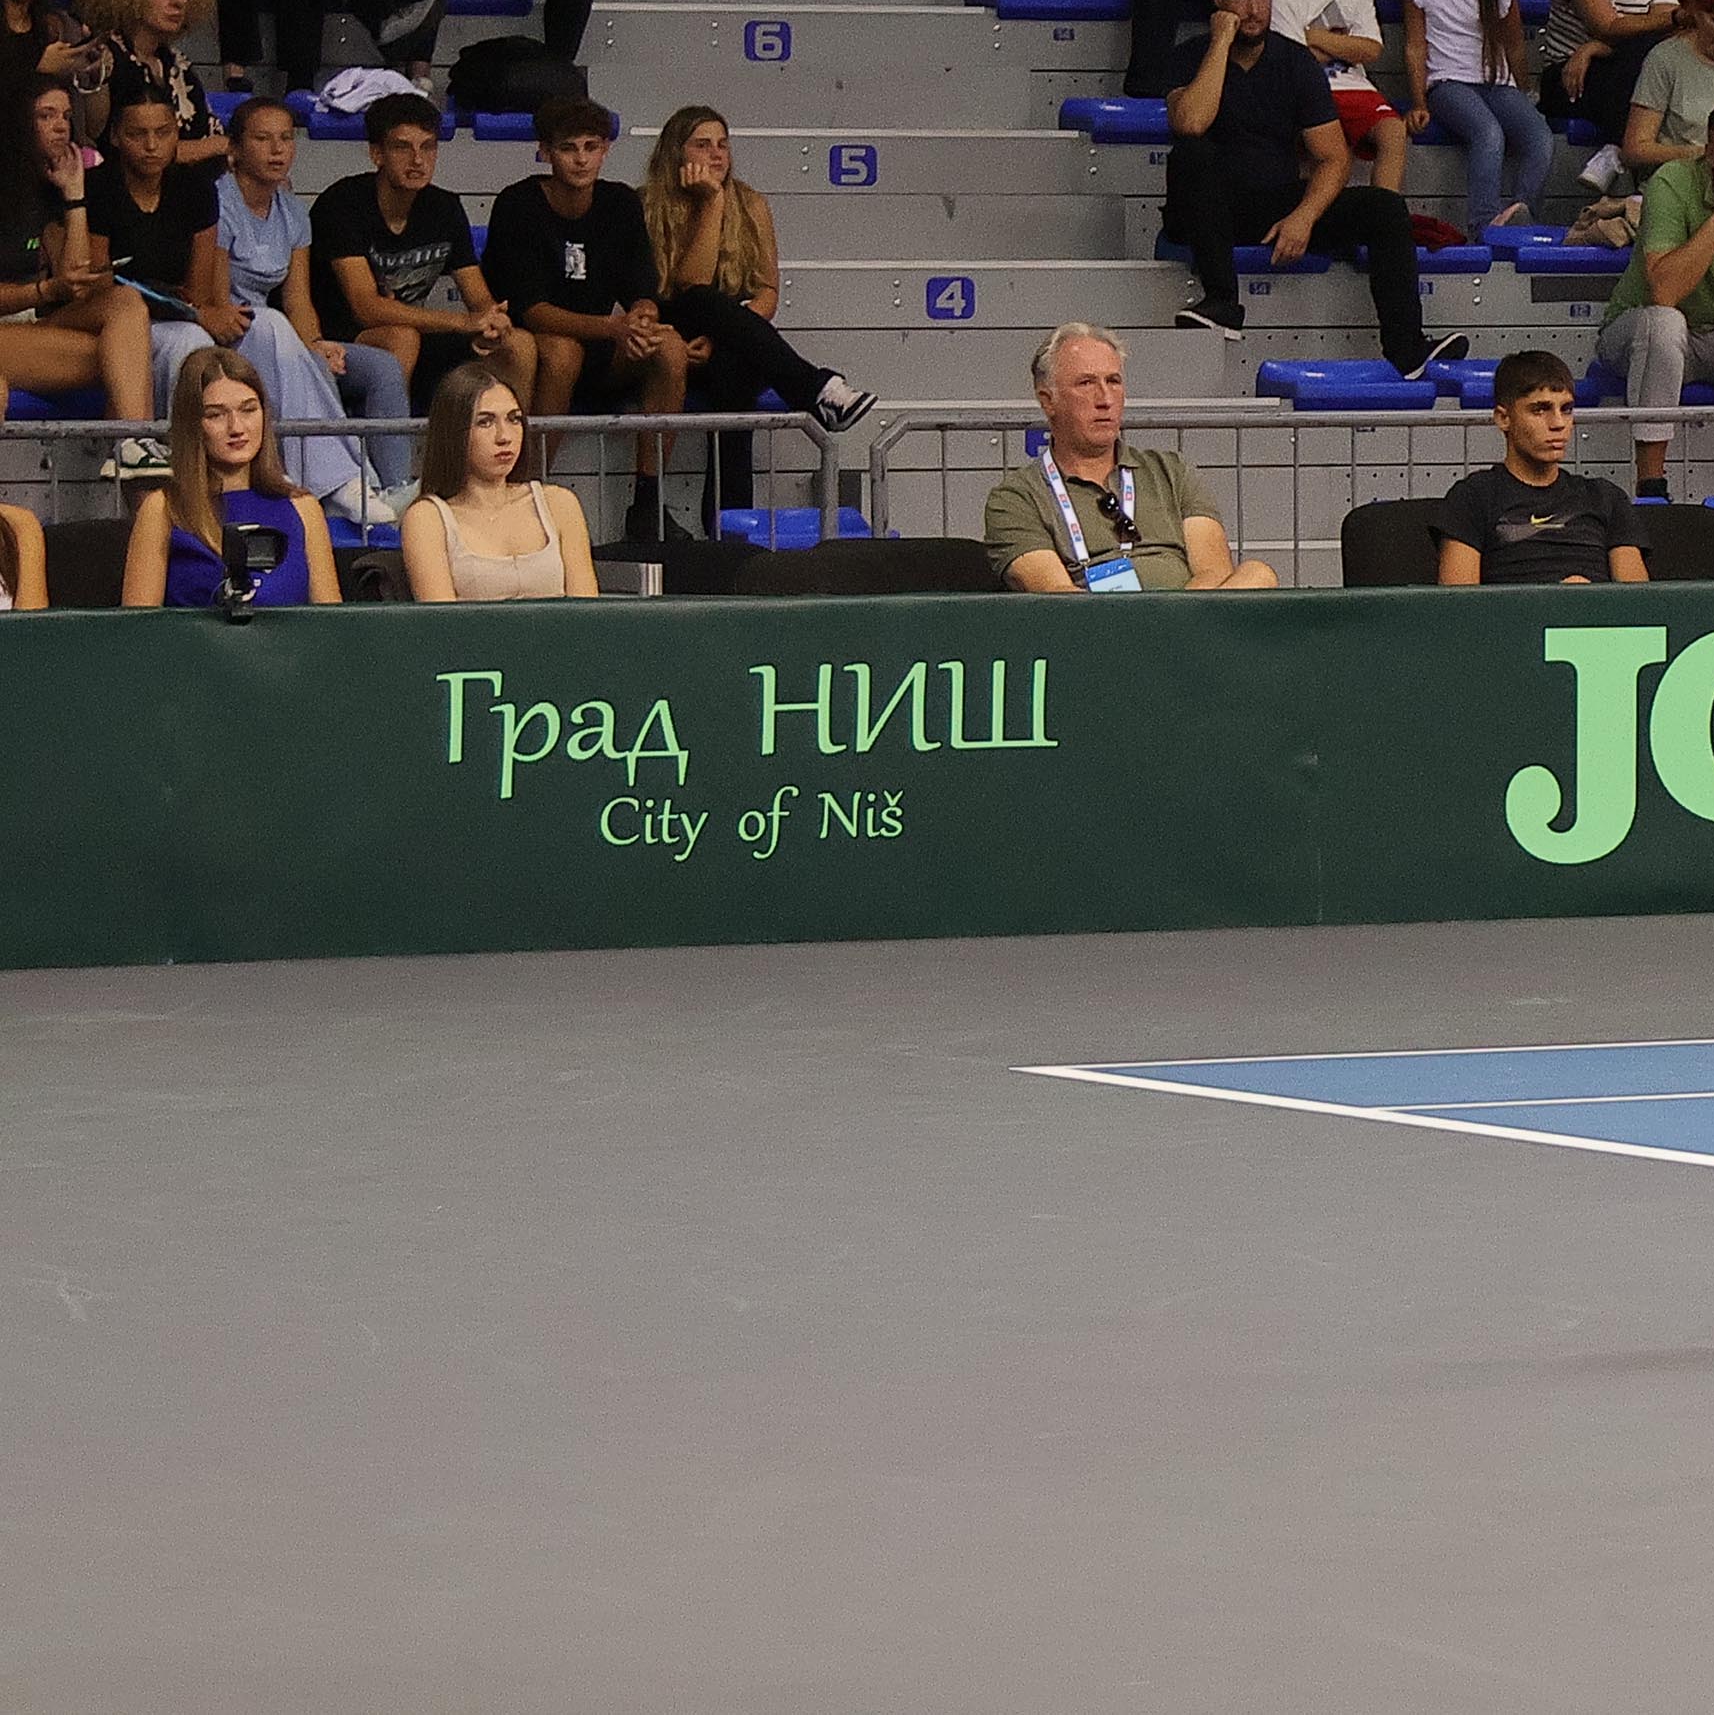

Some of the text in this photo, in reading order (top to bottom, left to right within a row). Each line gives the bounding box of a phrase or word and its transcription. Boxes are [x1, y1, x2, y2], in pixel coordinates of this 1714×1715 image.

[754, 23, 784, 60] 6
[839, 147, 869, 184] 5
[935, 279, 967, 318] 4
[435, 657, 1060, 799] Град НИШ
[599, 786, 906, 863] City of Niš
